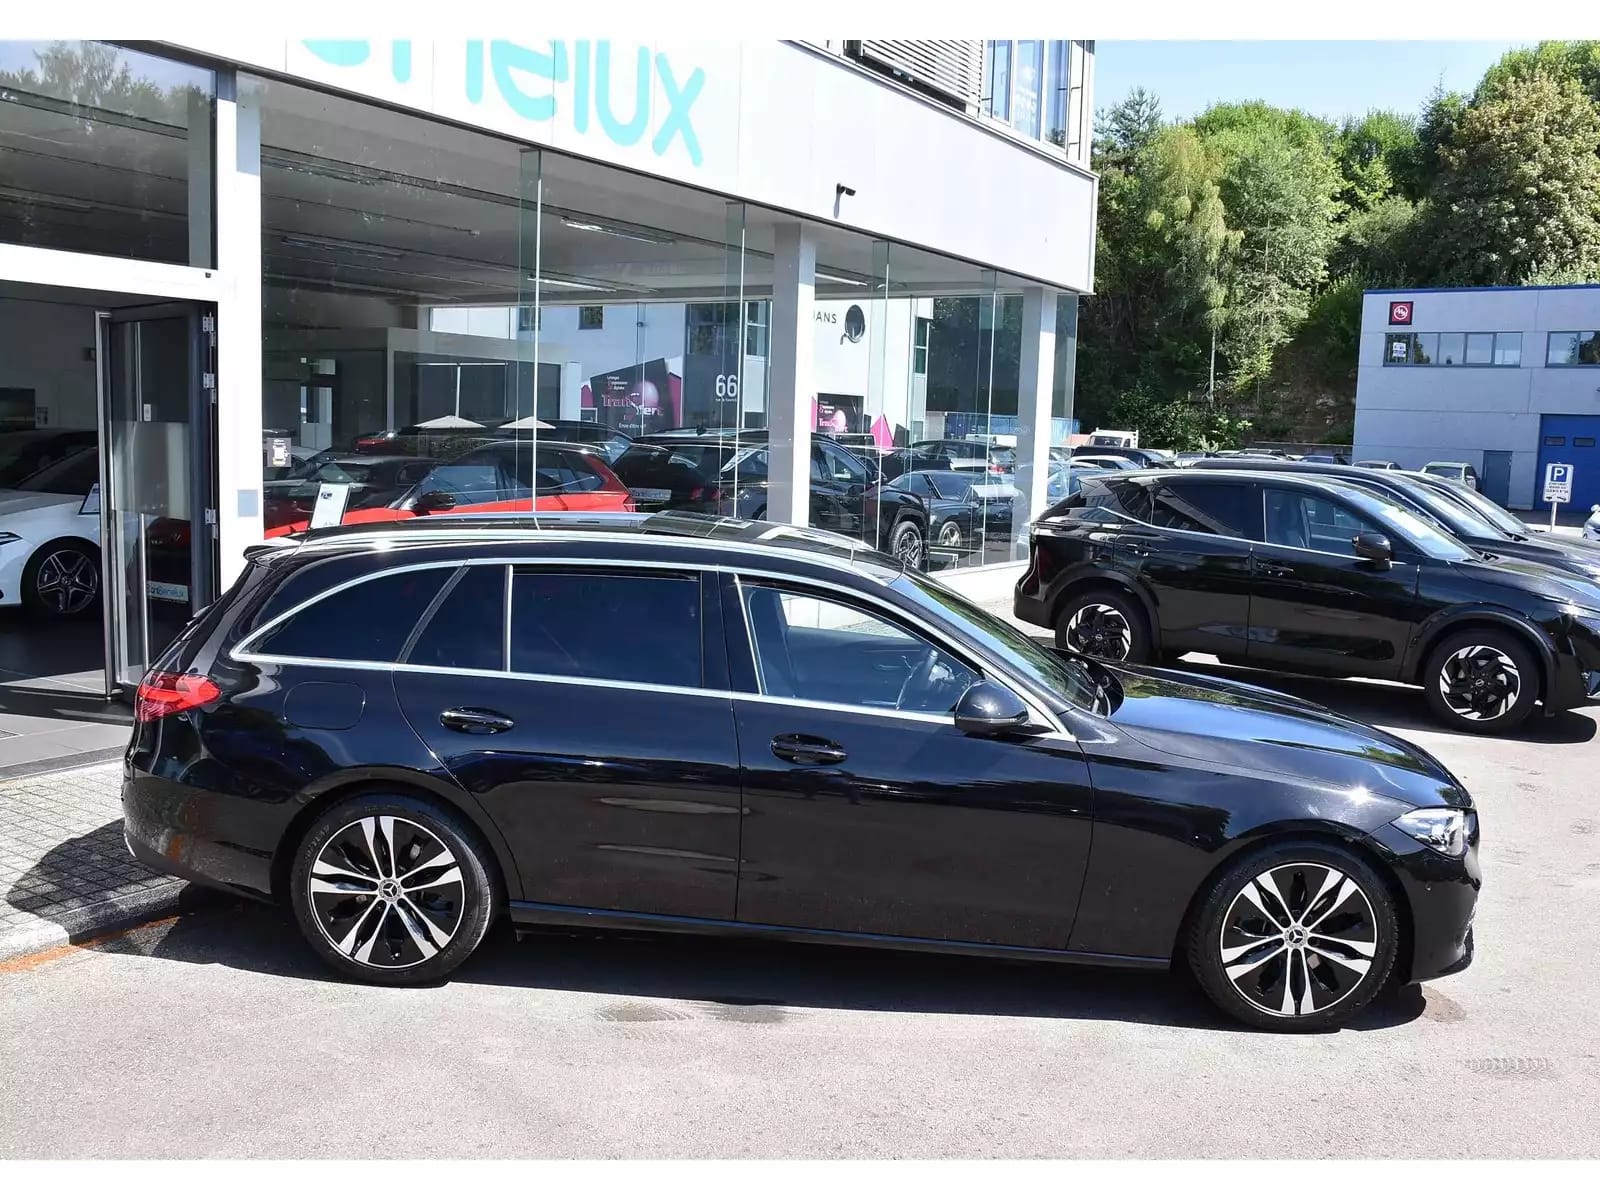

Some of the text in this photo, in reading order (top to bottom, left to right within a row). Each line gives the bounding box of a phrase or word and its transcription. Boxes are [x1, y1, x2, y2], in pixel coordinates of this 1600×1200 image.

[300, 40, 706, 167] elux
[813, 311, 837, 324] ANS
[715, 374, 738, 397] 66
[1553, 467, 1565, 481] P
